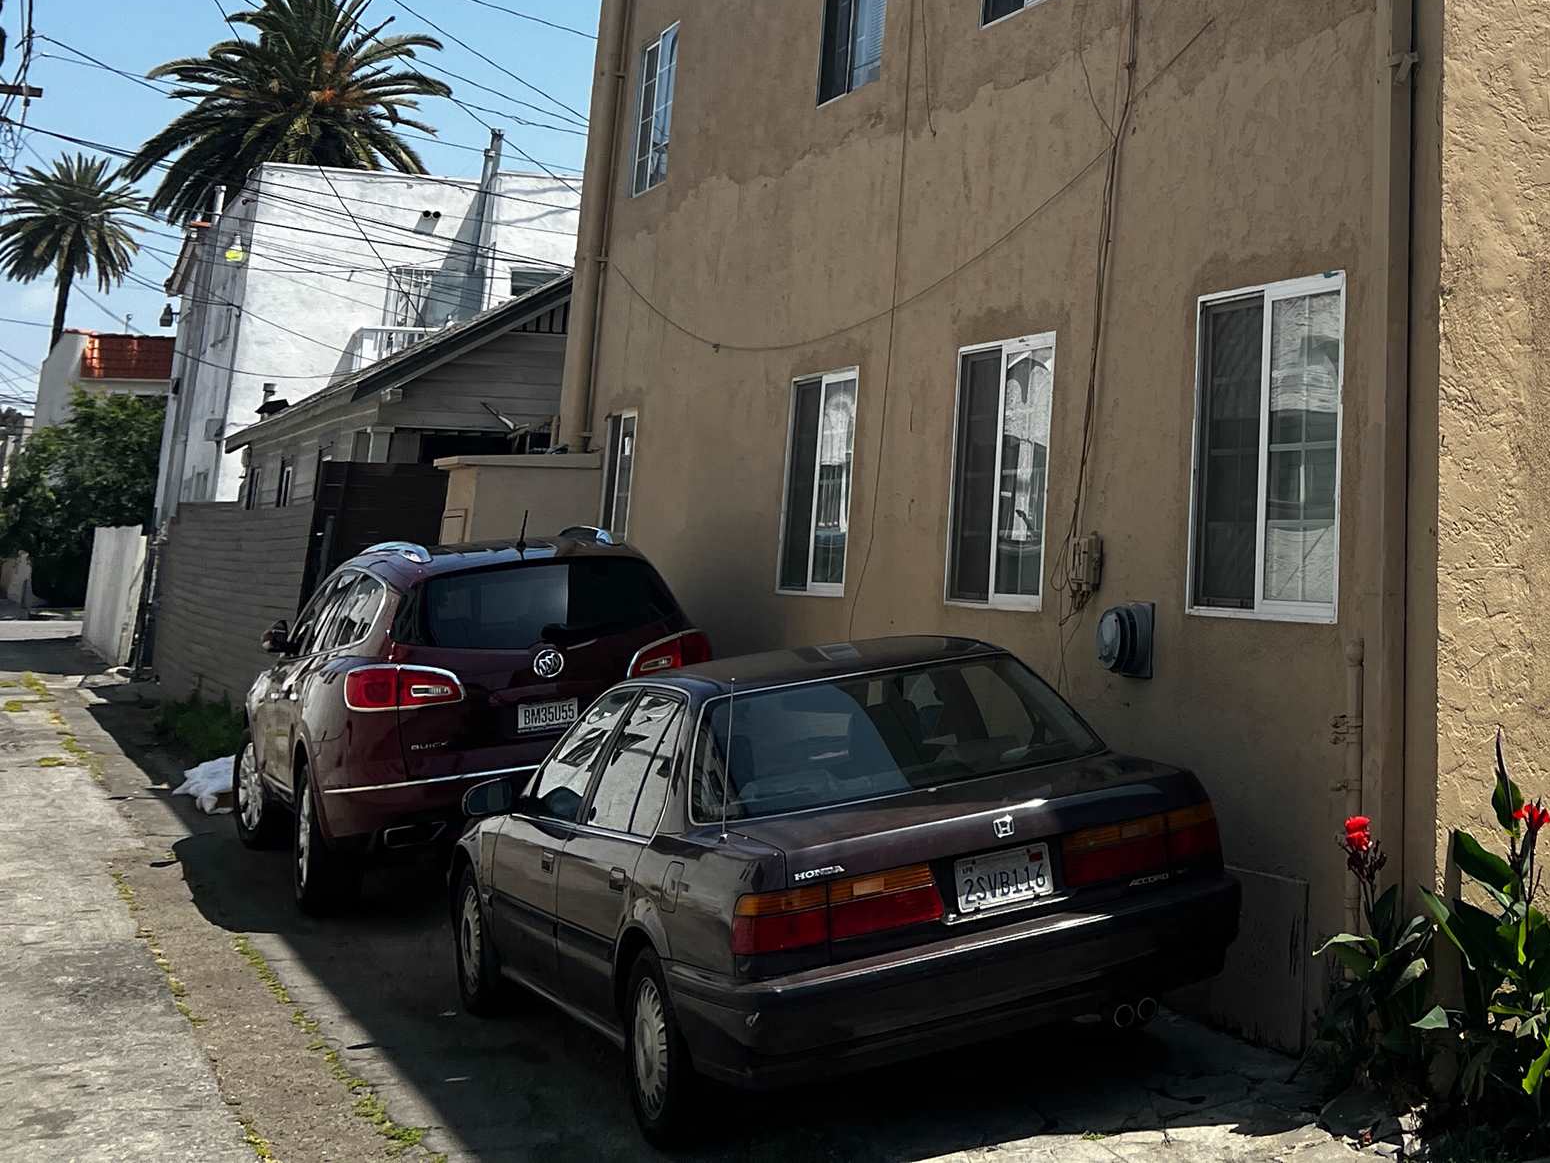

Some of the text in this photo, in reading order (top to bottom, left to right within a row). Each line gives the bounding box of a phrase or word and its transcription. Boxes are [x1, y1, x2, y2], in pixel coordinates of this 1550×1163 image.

[523, 703, 575, 726] BM35U55
[794, 865, 845, 881] HONDA
[963, 863, 1046, 905] 2SVB116
